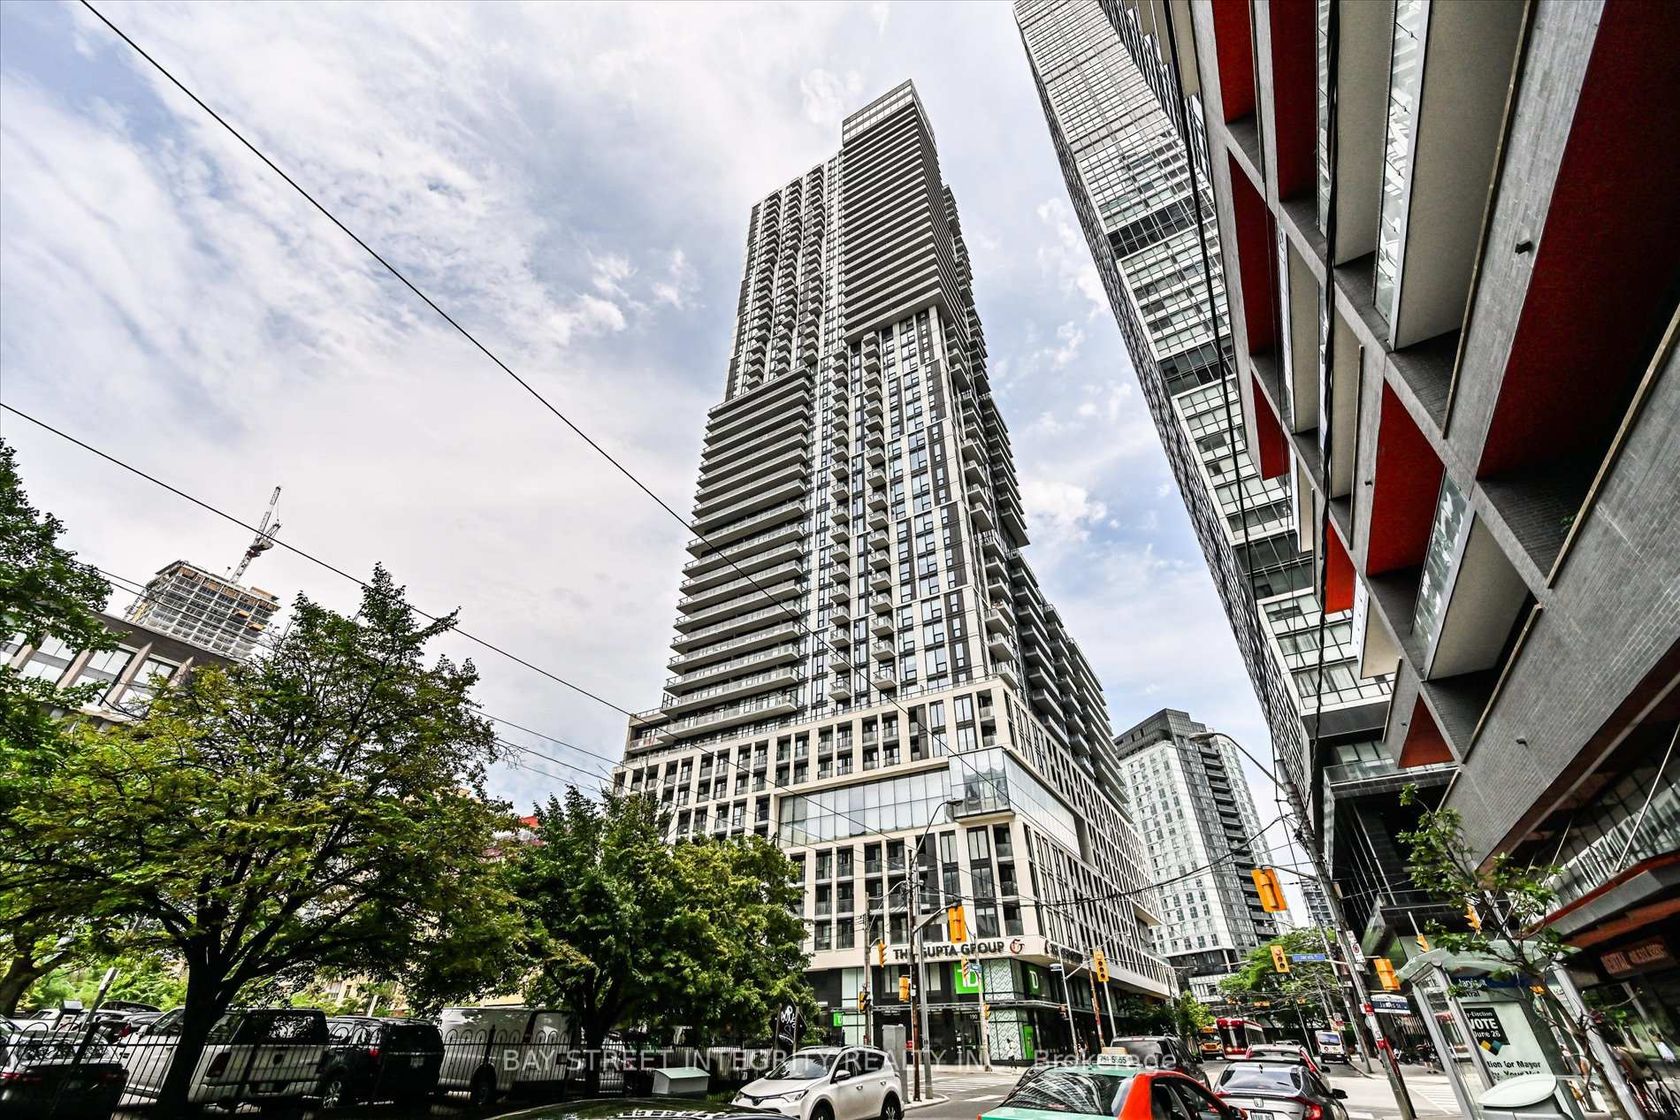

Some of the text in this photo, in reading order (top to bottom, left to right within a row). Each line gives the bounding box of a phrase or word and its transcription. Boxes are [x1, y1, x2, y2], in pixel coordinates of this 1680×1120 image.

[893, 941, 1005, 959] TH GUPTA GROUP
[957, 969, 979, 987] TD
[1470, 1018, 1498, 1029] VOTE
[1516, 1060, 1541, 1069] Mayor
